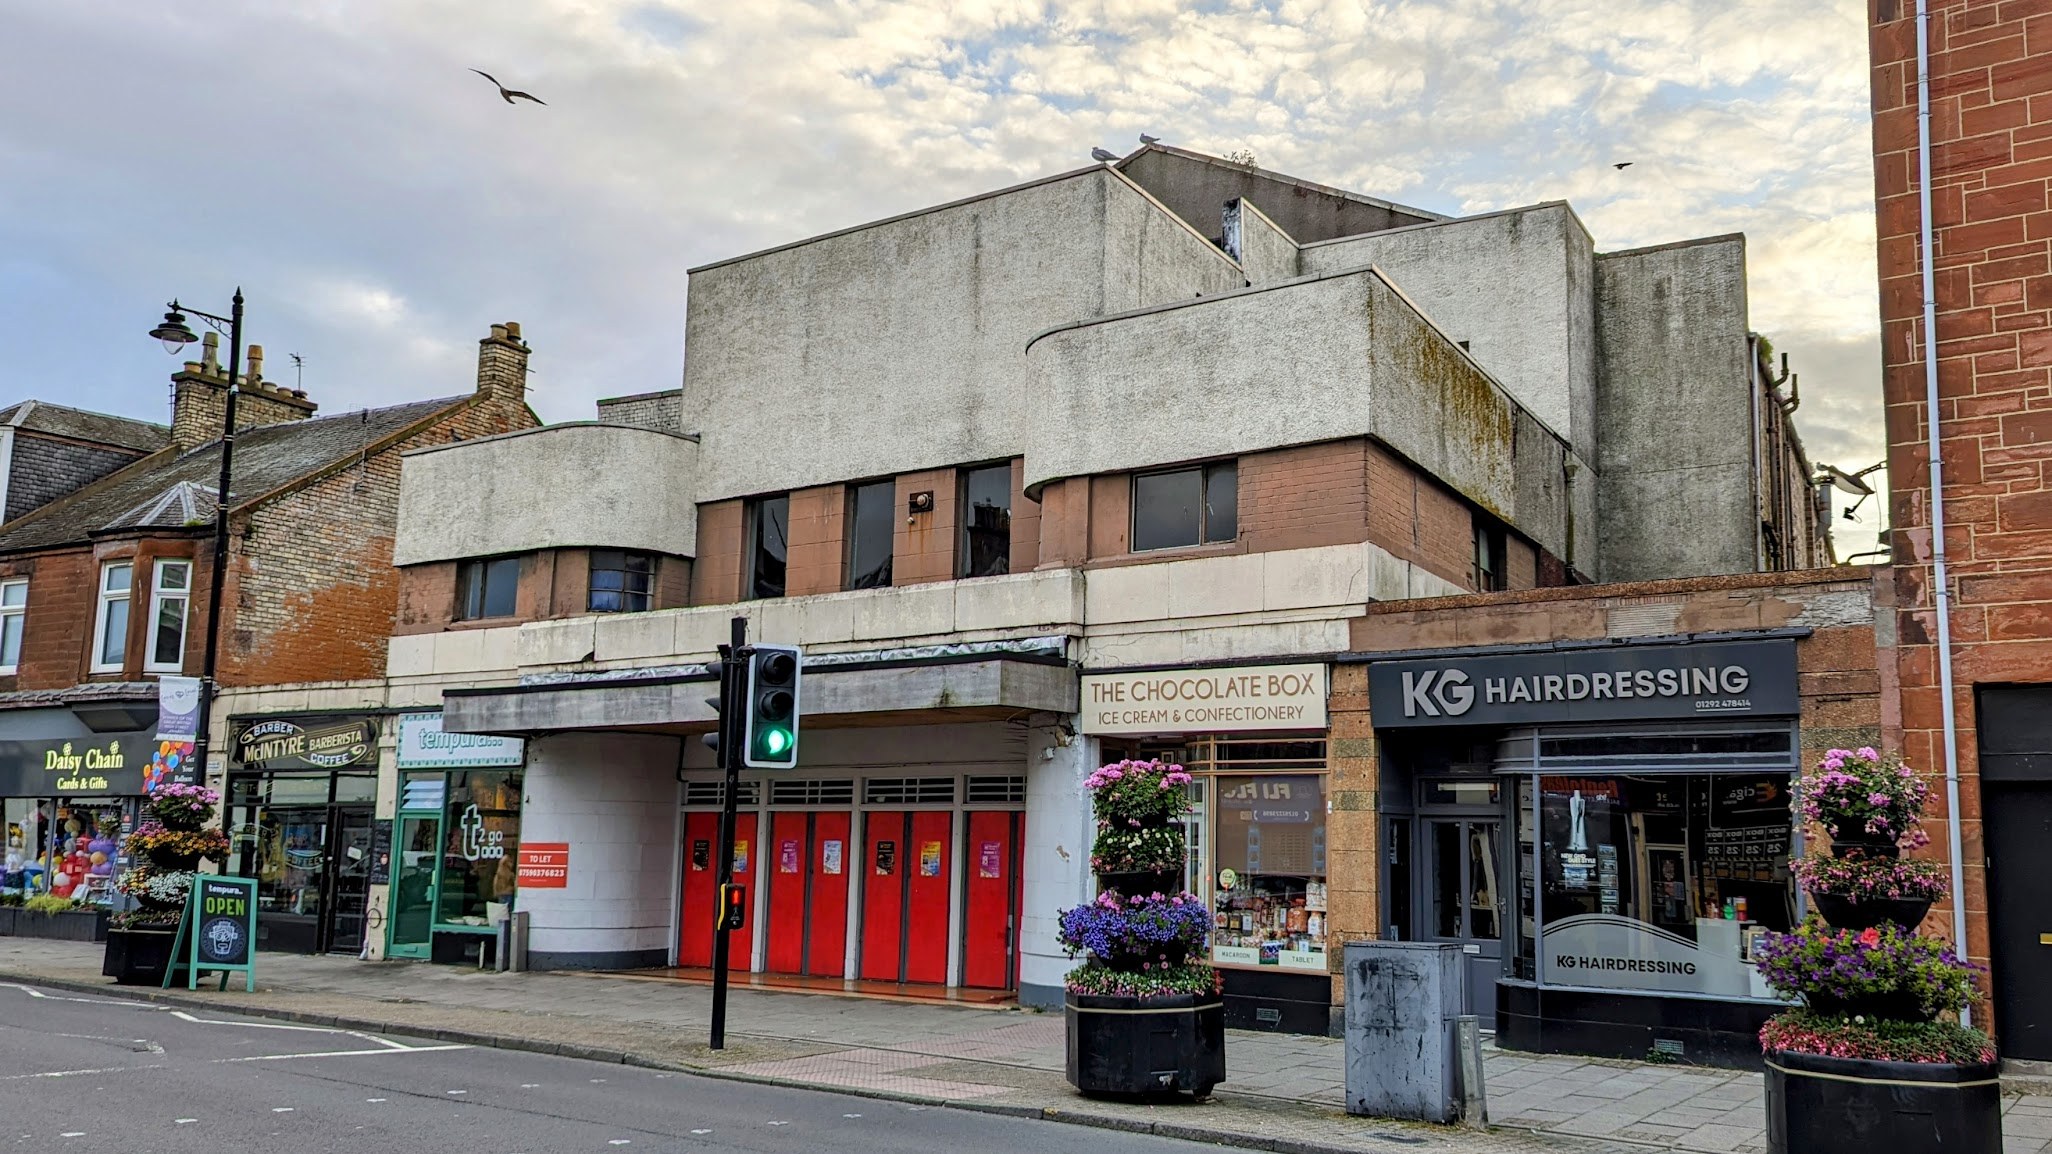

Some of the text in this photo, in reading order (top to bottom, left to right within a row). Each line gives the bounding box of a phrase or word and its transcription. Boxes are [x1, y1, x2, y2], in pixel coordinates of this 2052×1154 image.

[1091, 673, 1315, 703] THE CHOCOLATE BOX
[1402, 665, 1750, 717] KG HAIRDRESSING
[1695, 699, 1752, 708] 01292 478414
[1098, 705, 1304, 725] ICE CREAM & CONFECTIONERY
[253, 722, 294, 737] BARBER
[243, 735, 306, 763] McINTYRE
[308, 730, 362, 751] BARBERISTA
[45, 742, 124, 776] Daisy Chain
[309, 752, 350, 766] COFFEE
[182, 765, 194, 773] Your
[57, 776, 108, 790] Cards & Gifts
[478, 828, 485, 843] 2
[488, 831, 503, 846] go
[529, 855, 552, 863] TO LET
[206, 897, 245, 916] OPEN
[1221, 951, 1251, 959] MACAROON
[1291, 955, 1314, 964] TABLET
[1556, 955, 1696, 975] KG HAIRDRESSING
